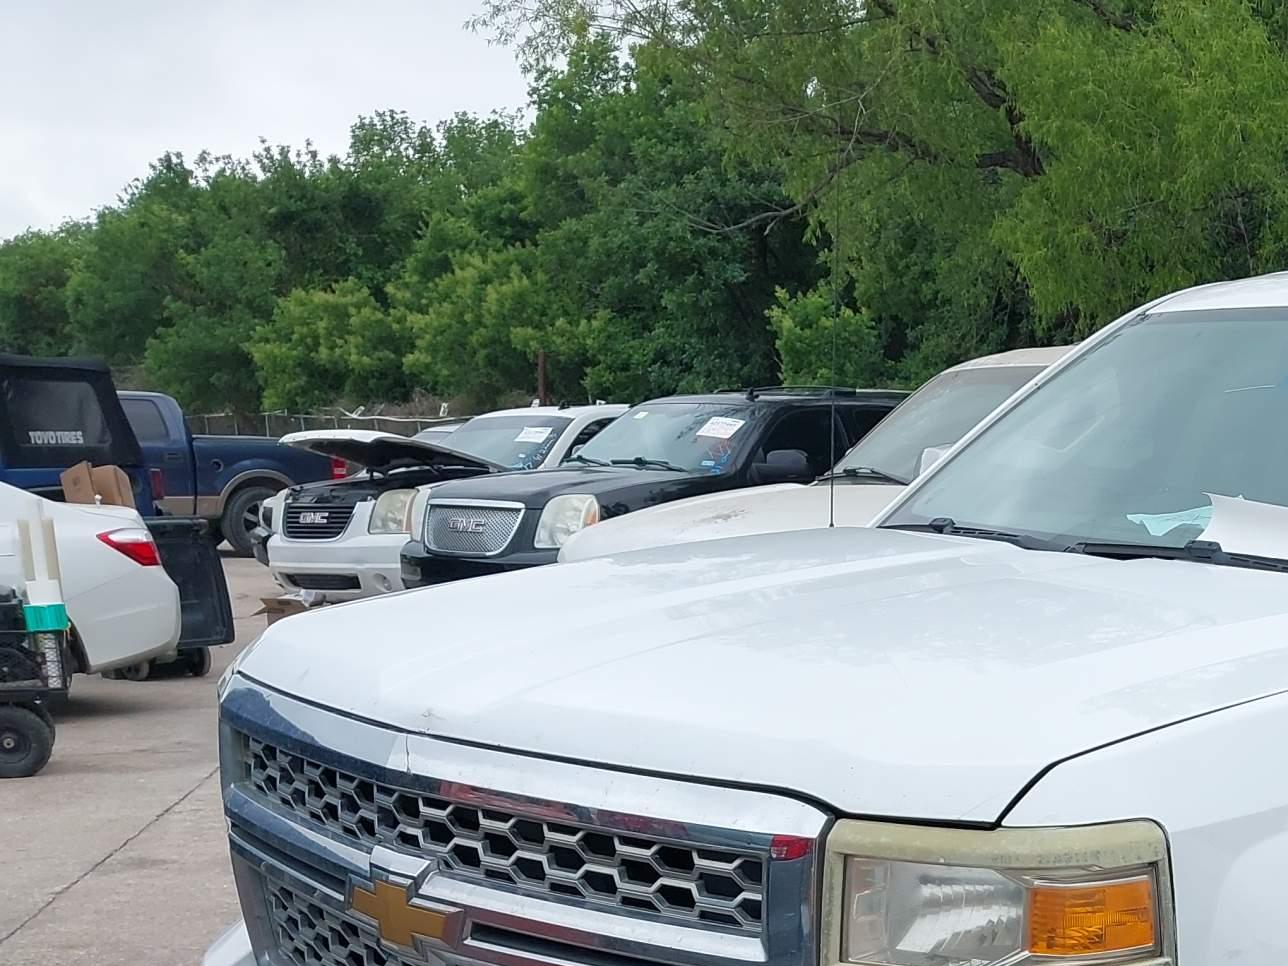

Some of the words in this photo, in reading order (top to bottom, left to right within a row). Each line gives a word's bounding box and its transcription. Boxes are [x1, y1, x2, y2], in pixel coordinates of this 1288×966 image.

[28, 430, 56, 444] TOYO
[56, 430, 84, 444] TIRES
[299, 512, 329, 524] GMC
[449, 517, 485, 533] GMC
